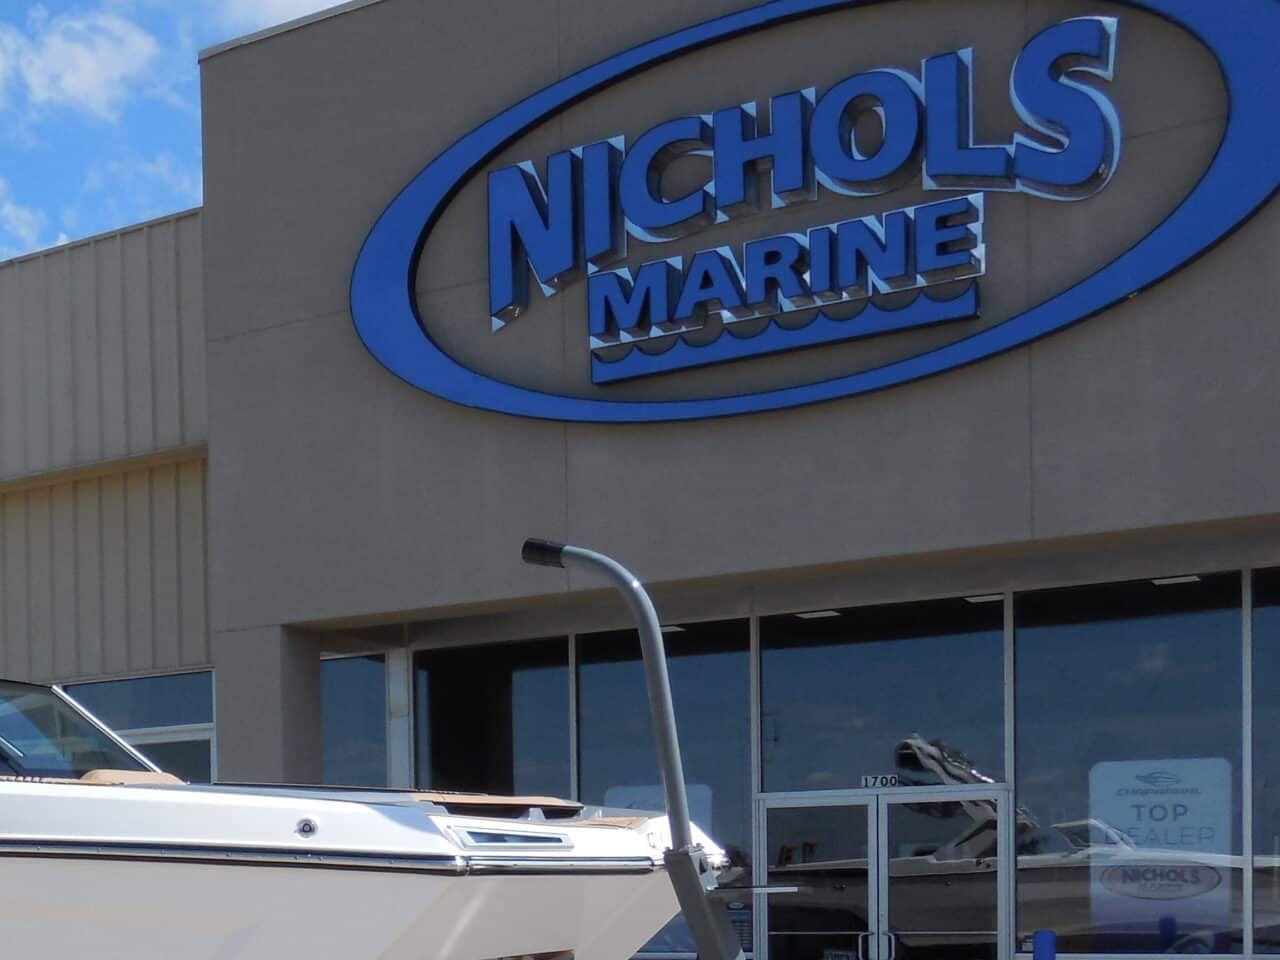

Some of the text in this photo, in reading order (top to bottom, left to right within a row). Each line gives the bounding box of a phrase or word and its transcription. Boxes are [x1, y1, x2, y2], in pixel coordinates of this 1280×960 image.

[488, 17, 1119, 331] NICHOLS
[588, 192, 986, 348] MARINE
[863, 775, 898, 788] 1700
[1129, 803, 1189, 822] TOP
[1121, 867, 1201, 884] NICHOLS
